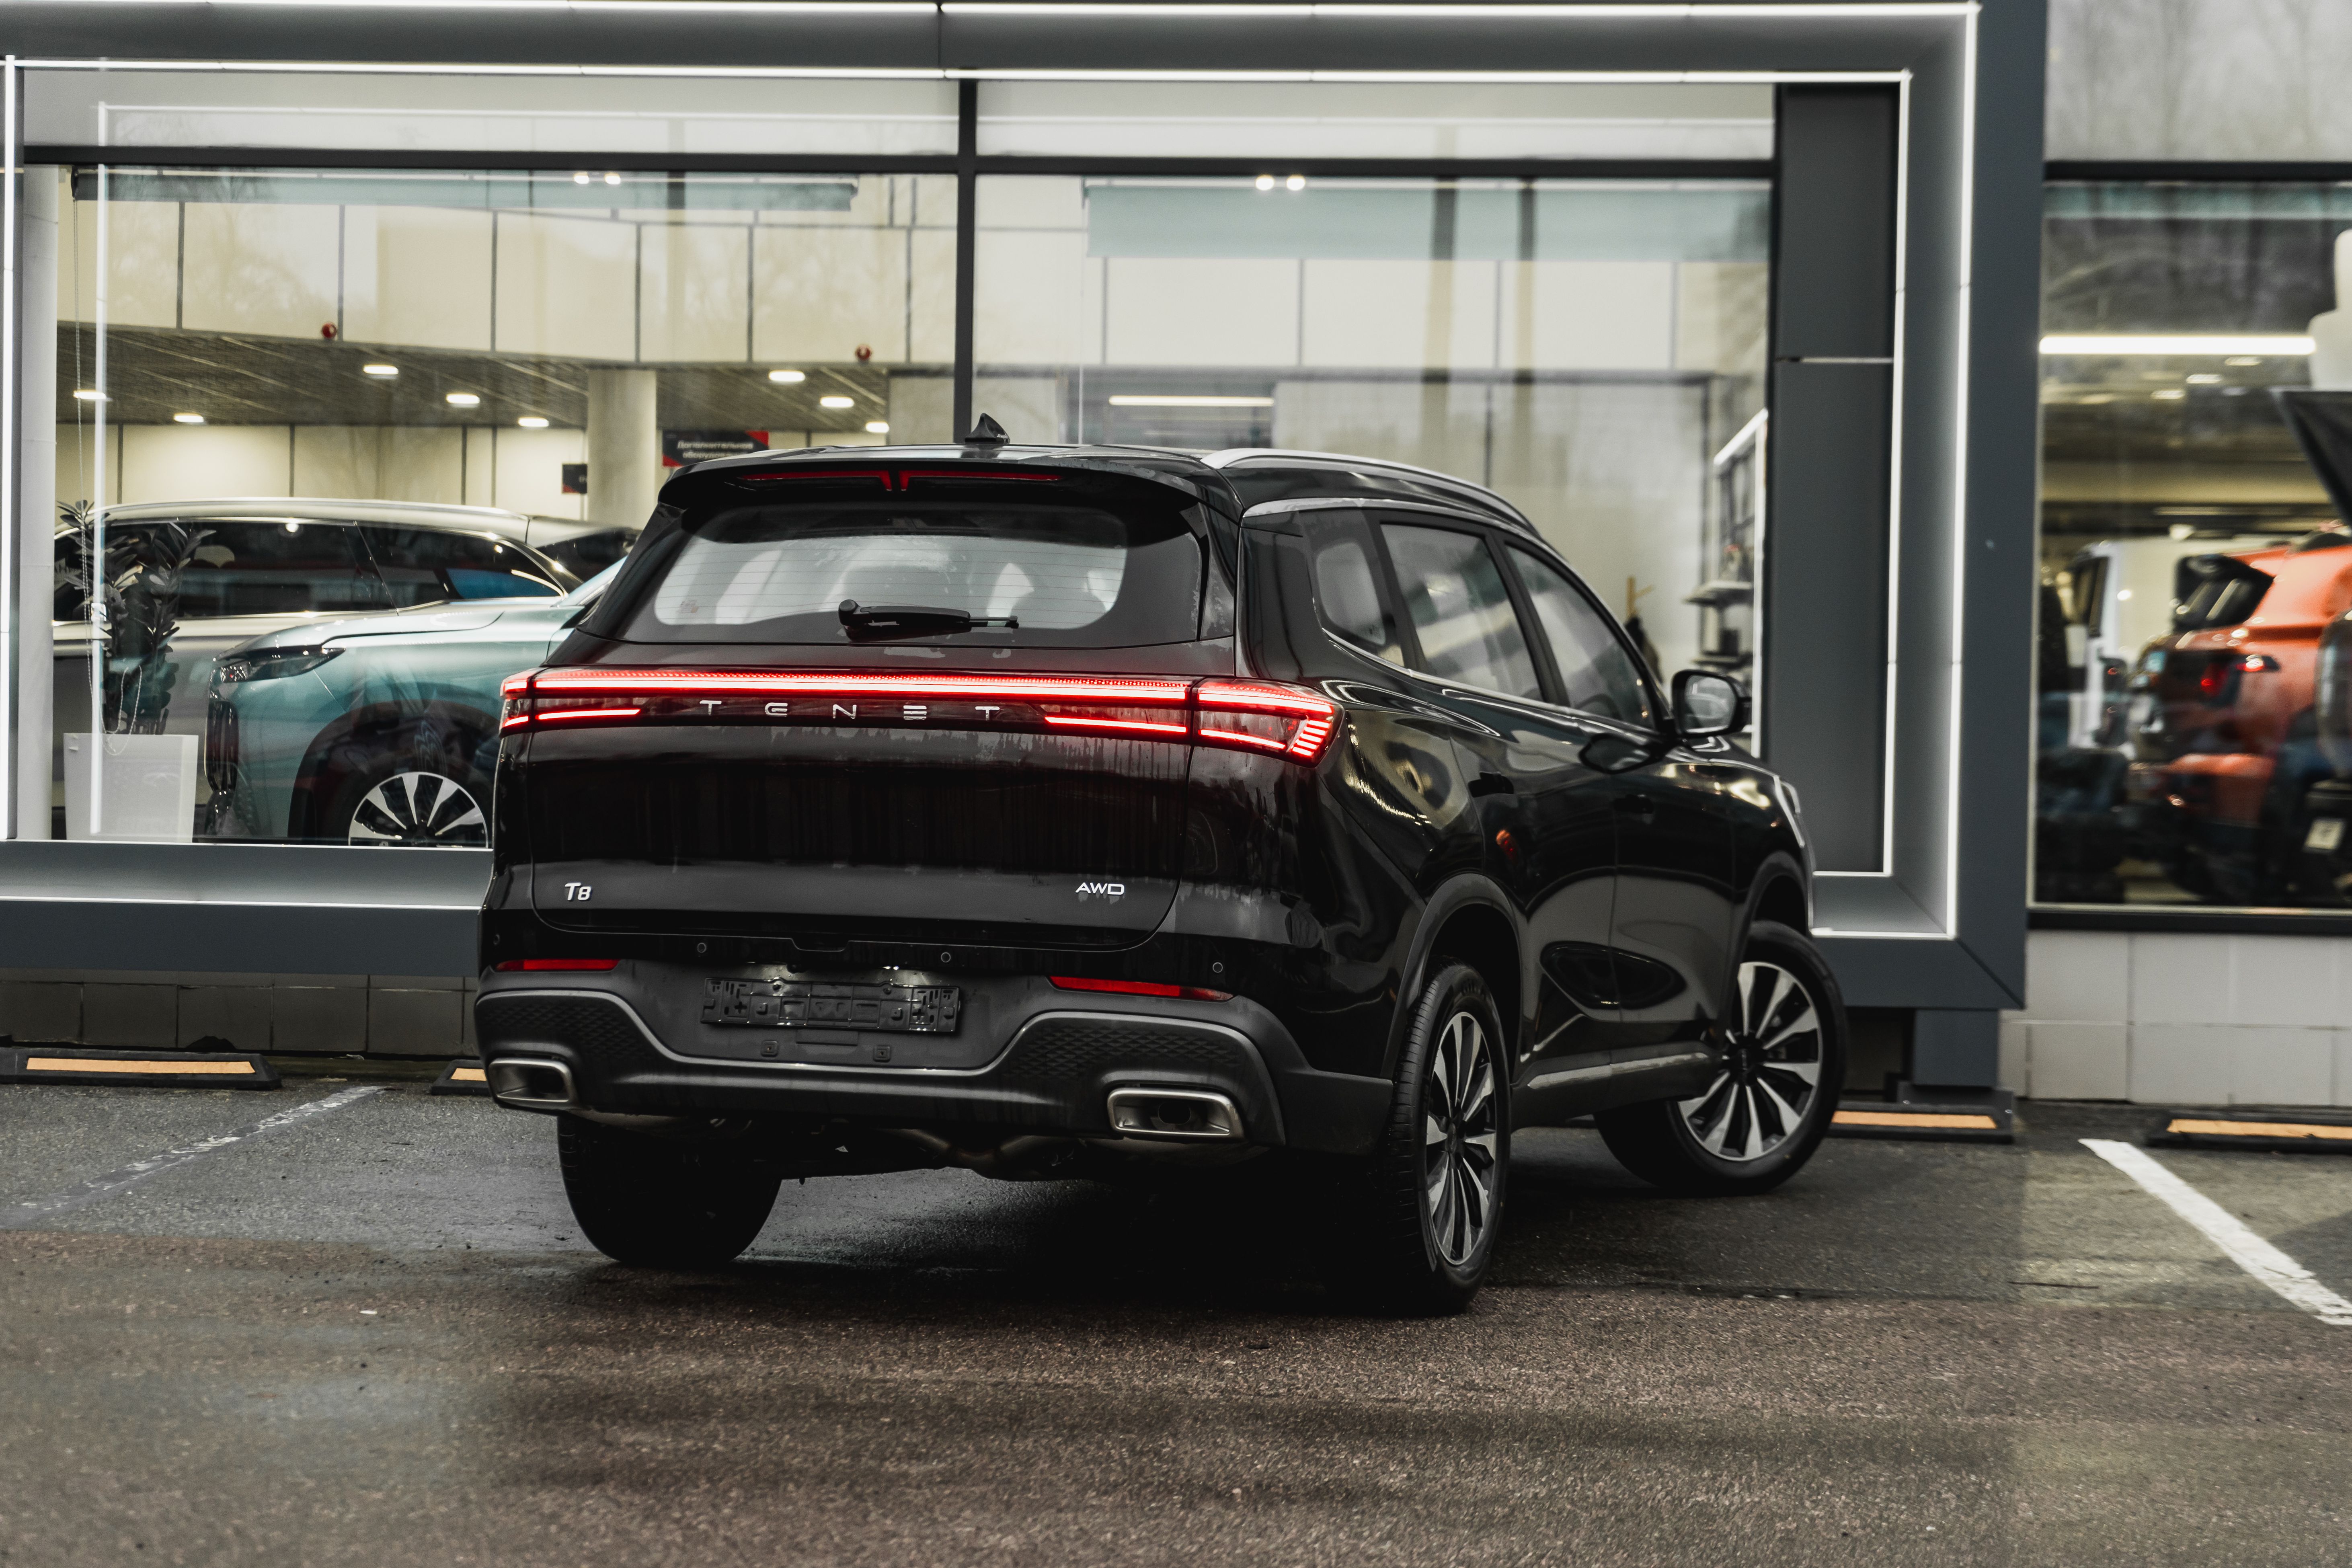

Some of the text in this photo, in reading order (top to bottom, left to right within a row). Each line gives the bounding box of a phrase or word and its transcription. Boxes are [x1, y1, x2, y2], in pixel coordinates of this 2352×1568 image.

[699, 700, 1000, 721] TENET
[564, 882, 591, 901] T8
[1075, 882, 1125, 895] AWD
